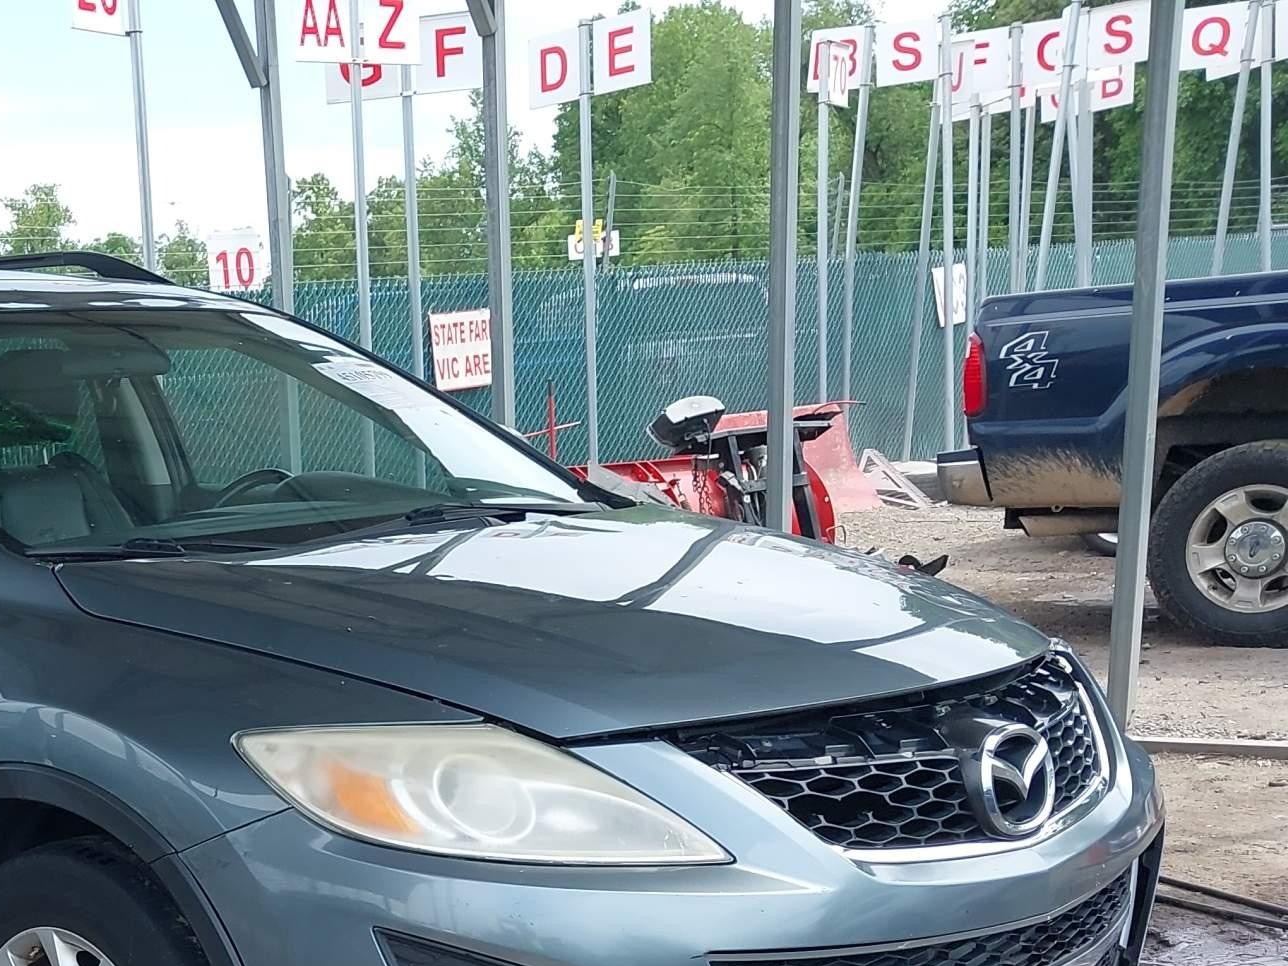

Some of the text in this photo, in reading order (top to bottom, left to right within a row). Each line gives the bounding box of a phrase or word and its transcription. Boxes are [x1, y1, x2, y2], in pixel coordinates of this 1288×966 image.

[300, 0, 345, 47] AA
[379, 0, 406, 49] Z
[1103, 15, 1133, 54] S
[1191, 17, 1230, 57] Q
[435, 26, 466, 78] F
[540, 46, 568, 92] D
[608, 26, 635, 77] E
[892, 32, 922, 71] S
[215, 247, 254, 289] 10
[433, 319, 490, 346] STATE FAR
[436, 357, 459, 380] VIC
